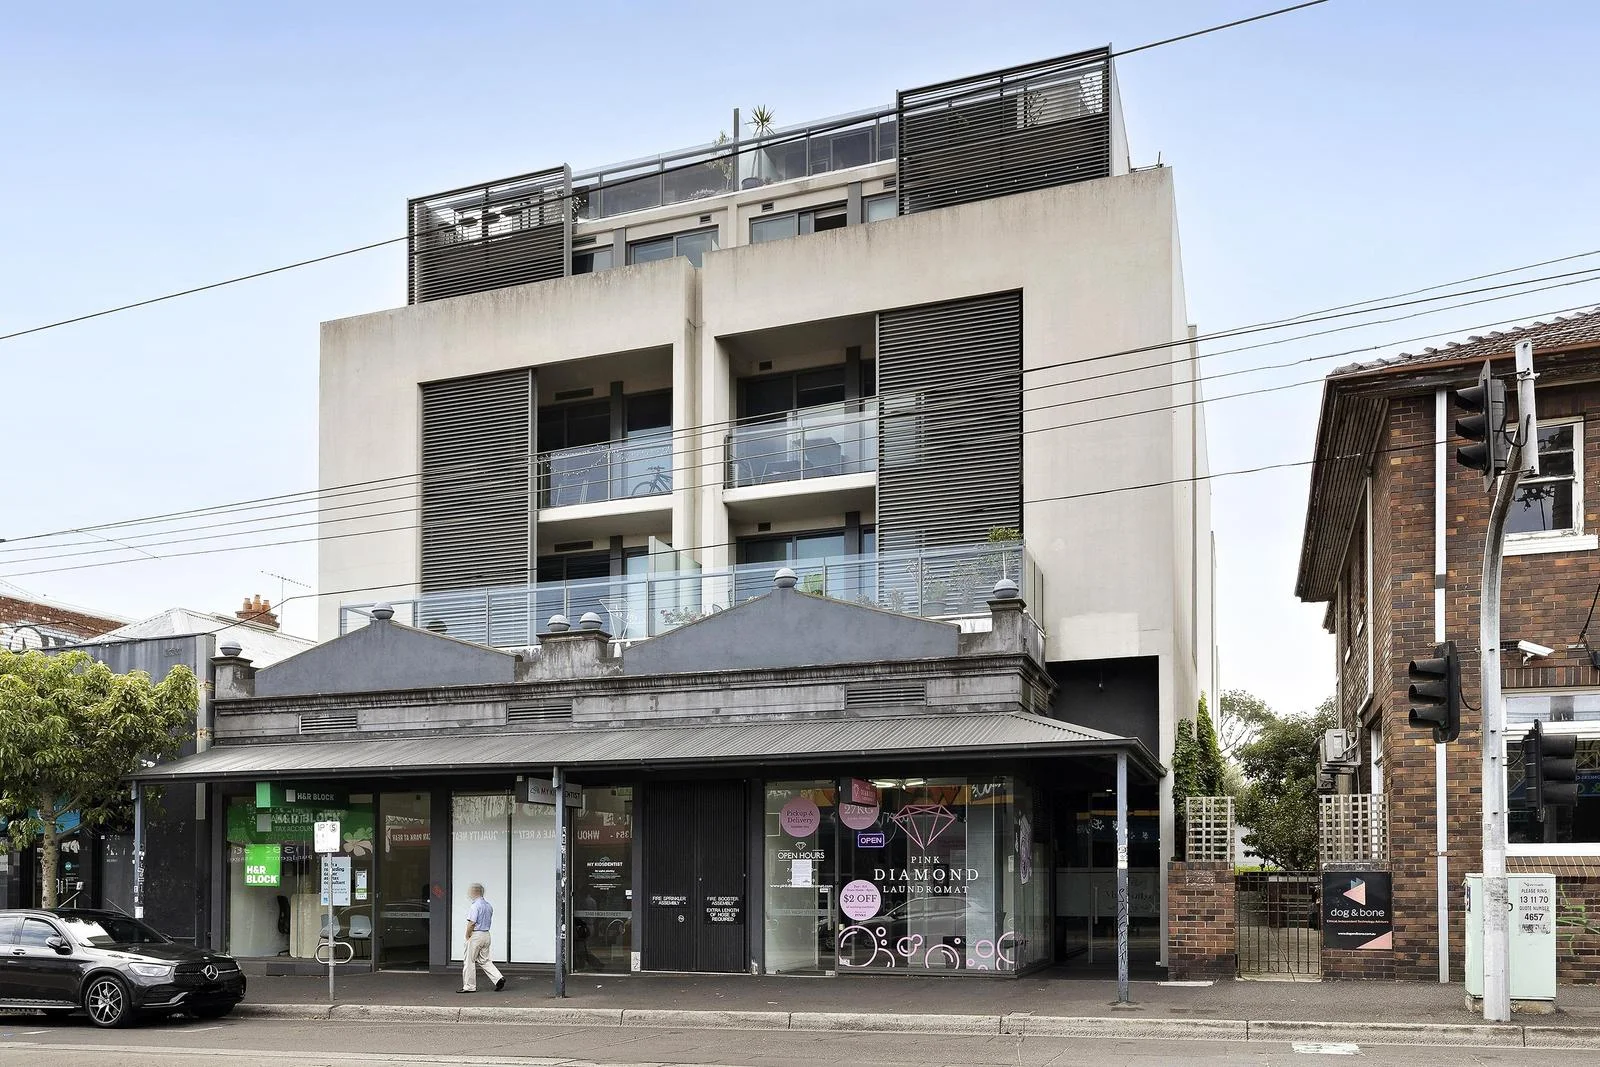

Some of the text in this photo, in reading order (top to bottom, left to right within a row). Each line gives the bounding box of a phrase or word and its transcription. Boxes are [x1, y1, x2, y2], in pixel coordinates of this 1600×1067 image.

[297, 792, 335, 801] H&R BLOCK
[860, 837, 882, 845] OPEN
[777, 852, 798, 860] OPEN
[911, 856, 940, 864] PINK
[246, 866, 266, 874] H&R
[873, 868, 979, 881] DIAMOND
[246, 875, 277, 883] BLOCK
[883, 885, 970, 894] LAUNDROMAT
[843, 894, 878, 904] $2 OFF
[1520, 896, 1549, 904] 13 11 70
[1330, 908, 1385, 918] dog & bone
[1524, 913, 1544, 921] 4657
